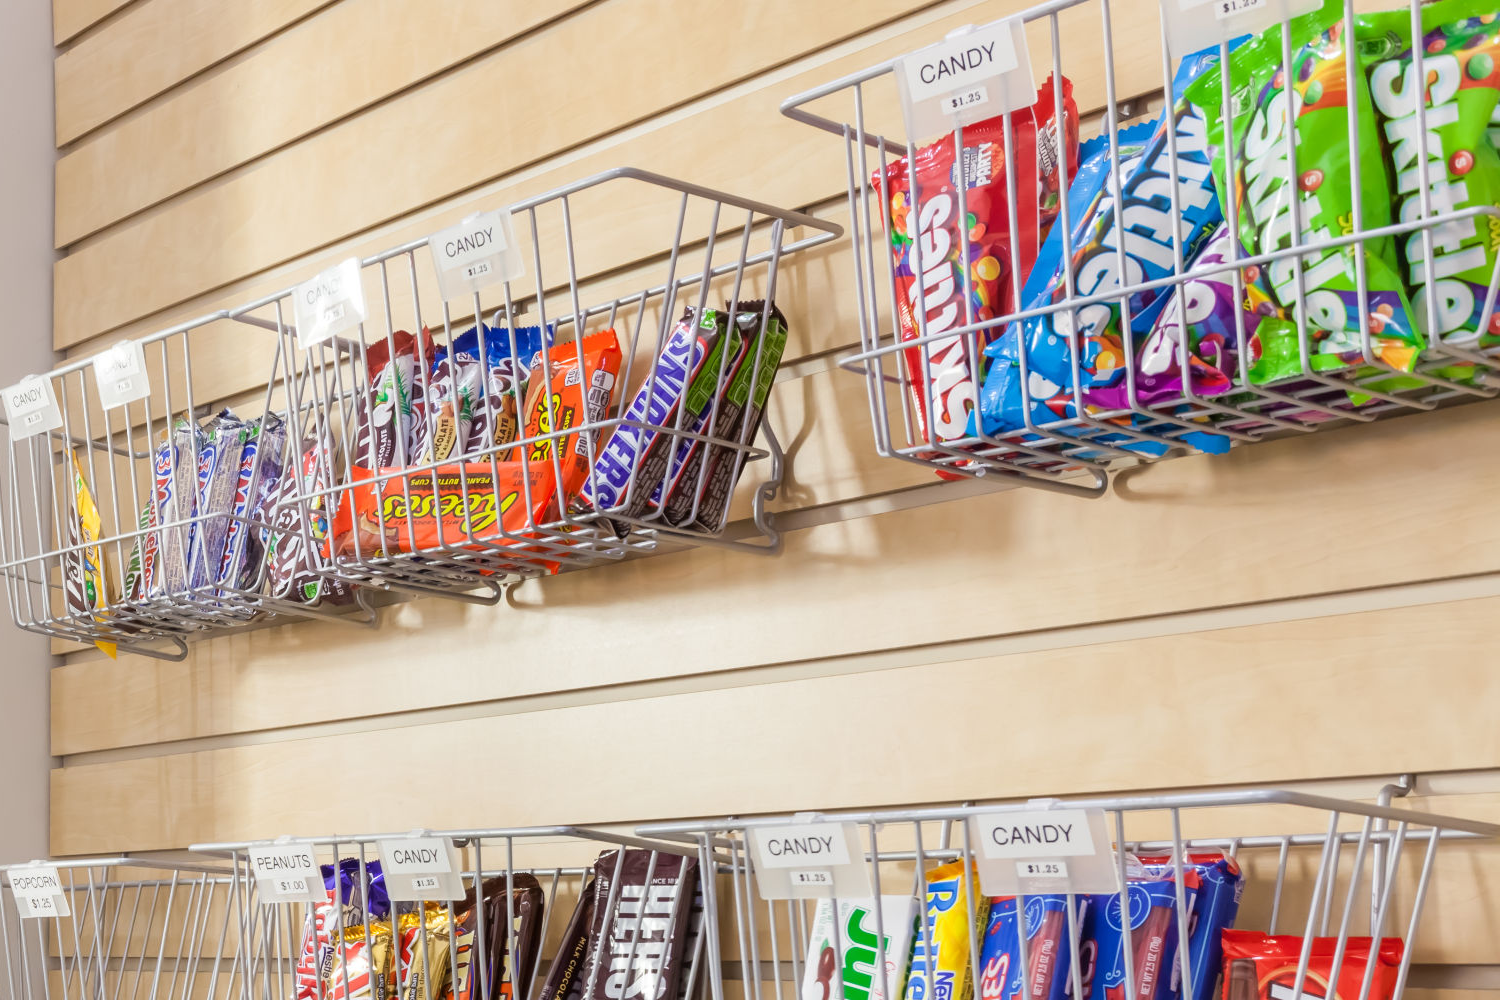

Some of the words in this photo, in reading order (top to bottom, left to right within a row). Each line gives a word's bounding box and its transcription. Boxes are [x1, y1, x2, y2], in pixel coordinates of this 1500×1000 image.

[920, 41, 995, 84] CANDY
[952, 91, 981, 108] $1.25
[976, 142, 993, 186] PARTY
[445, 228, 494, 258] CANDY
[468, 264, 488, 276] $1.25
[12, 388, 43, 408] CANDY
[582, 330, 707, 510] SNICKERS
[376, 491, 518, 534] Reese's
[992, 824, 1072, 845] CANDY
[768, 836, 832, 856] CANDY
[257, 854, 311, 870] PEANUTS
[393, 849, 438, 864] CANDY
[1028, 864, 1059, 874] $1.25
[13, 875, 57, 889] POPCORN
[417, 879, 435, 887] $1.25
[800, 873, 826, 882] $1.25
[281, 880, 305, 891] $1.00
[31, 898, 52, 909] $1.25
[573, 936, 587, 959] MILK
[1150, 947, 1159, 958] OZ
[1147, 959, 1156, 971] 2.5
[411, 972, 419, 989] bars
[1143, 970, 1153, 982] WT
[1140, 982, 1151, 996] NET
